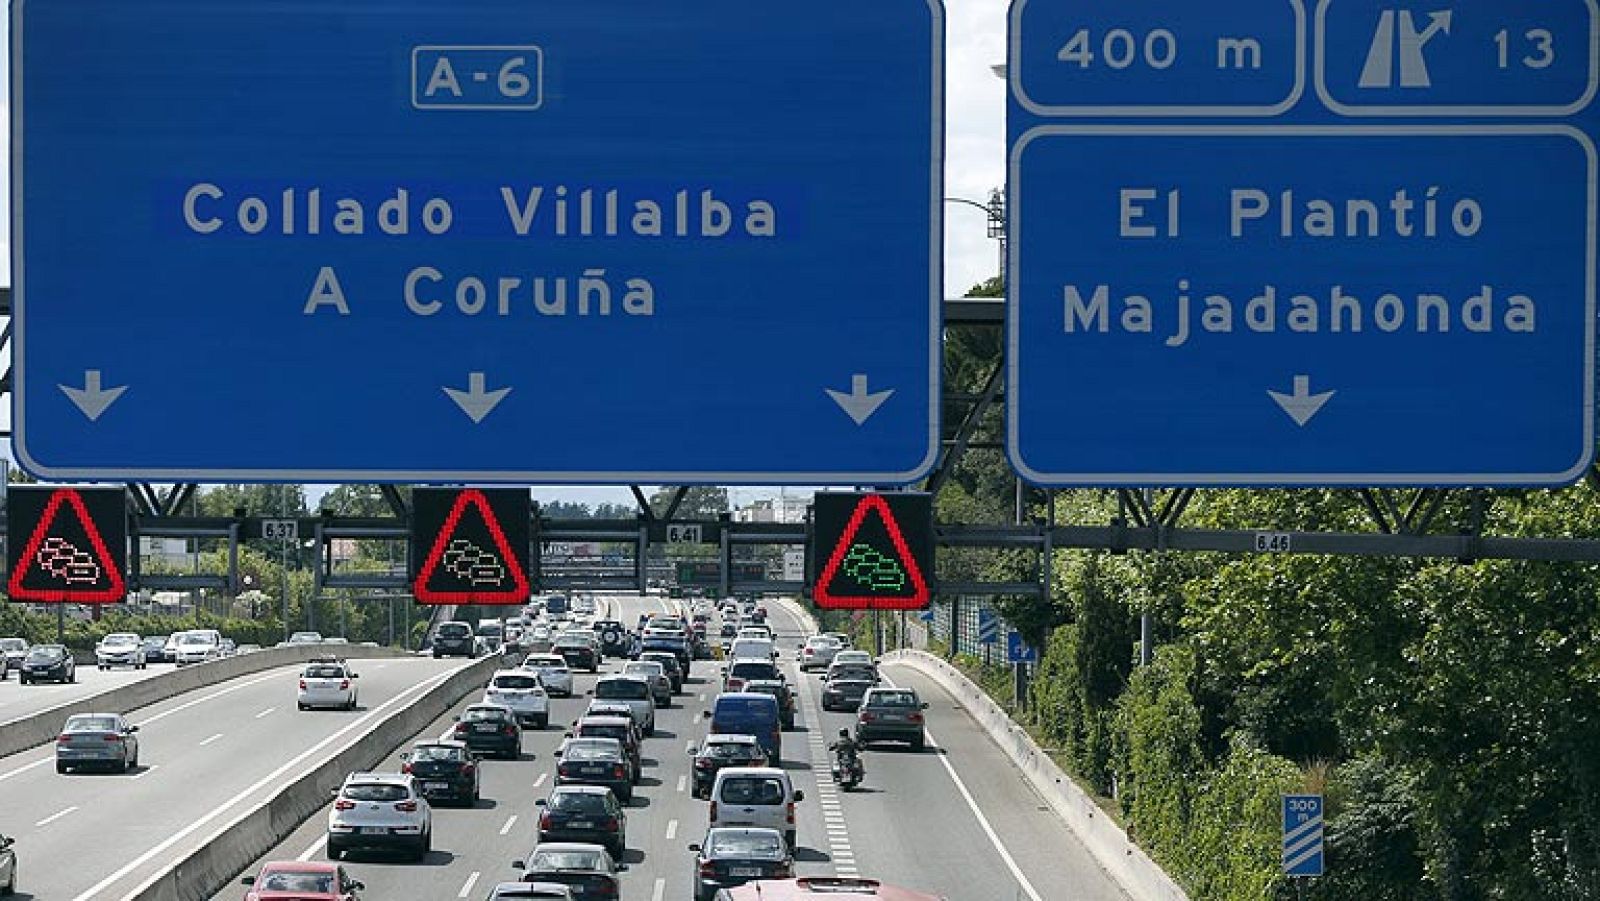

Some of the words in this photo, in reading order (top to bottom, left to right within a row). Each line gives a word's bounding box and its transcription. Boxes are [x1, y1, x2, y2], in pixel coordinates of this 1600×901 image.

[1059, 30, 1175, 67] 400
[1219, 40, 1258, 67] m
[1496, 31, 1553, 67] 13
[426, 58, 528, 97] A-6
[184, 184, 453, 235] Collado
[502, 186, 774, 236] Villalba
[1121, 190, 1178, 236] El
[1232, 188, 1482, 236] Plantío
[305, 267, 348, 314] A
[406, 267, 653, 315] Coruña
[1064, 282, 1534, 345] Majadahonda
[1289, 801, 1317, 812] 300
